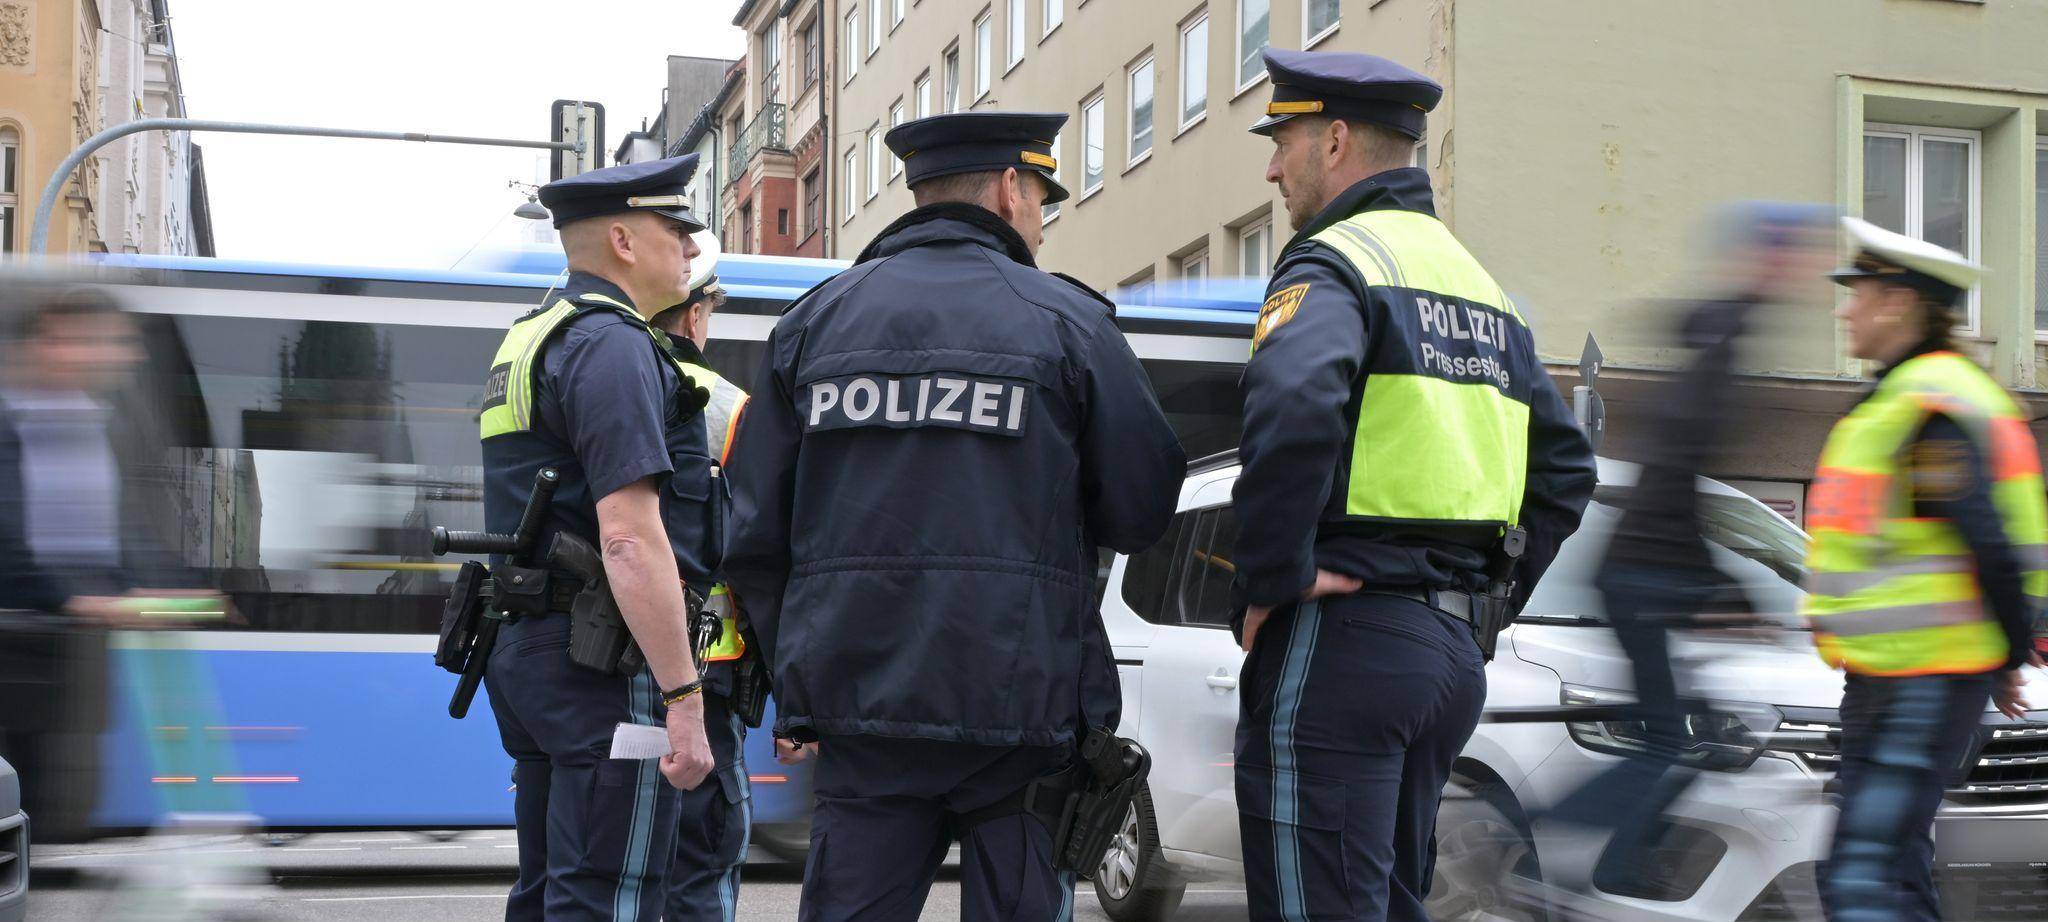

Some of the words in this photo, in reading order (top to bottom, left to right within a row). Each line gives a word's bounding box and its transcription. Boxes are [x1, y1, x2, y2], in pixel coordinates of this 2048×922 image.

[1262, 288, 1303, 316] POLIZEI
[1416, 297, 1506, 352] POLIZEI
[808, 377, 1025, 431] POLIZEI
